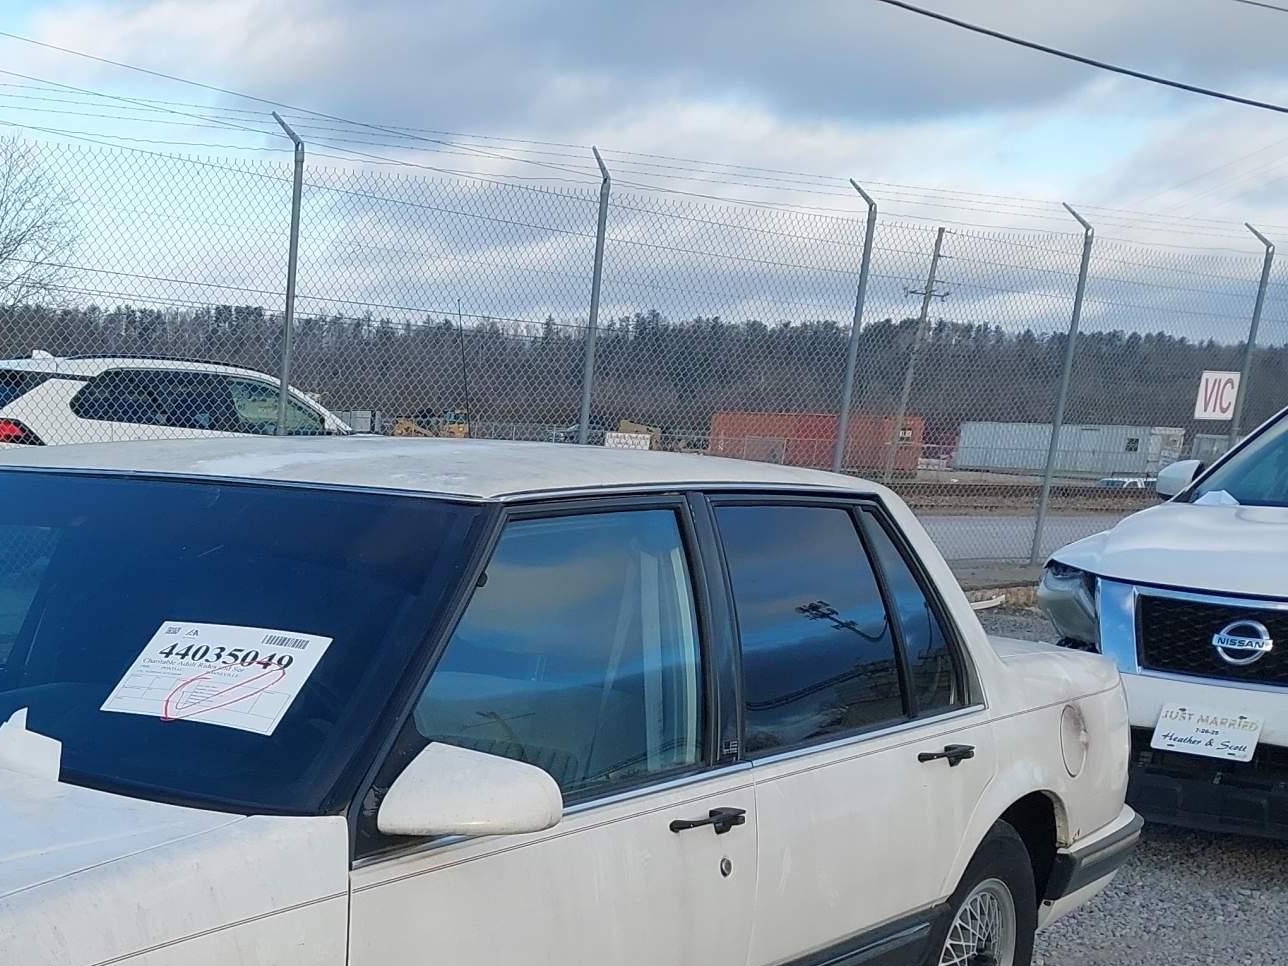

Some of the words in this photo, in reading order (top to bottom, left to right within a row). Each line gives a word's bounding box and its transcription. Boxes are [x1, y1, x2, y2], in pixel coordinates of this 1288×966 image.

[1203, 377, 1234, 414] VIC
[1217, 637, 1265, 649] NISSAN
[158, 643, 294, 669] 44035049
[1162, 710, 1194, 721] JUST
[1196, 714, 1258, 732] MARRIED
[1162, 732, 1201, 745] Heather
[1205, 738, 1213, 747] &
[1216, 740, 1248, 752] Scott
